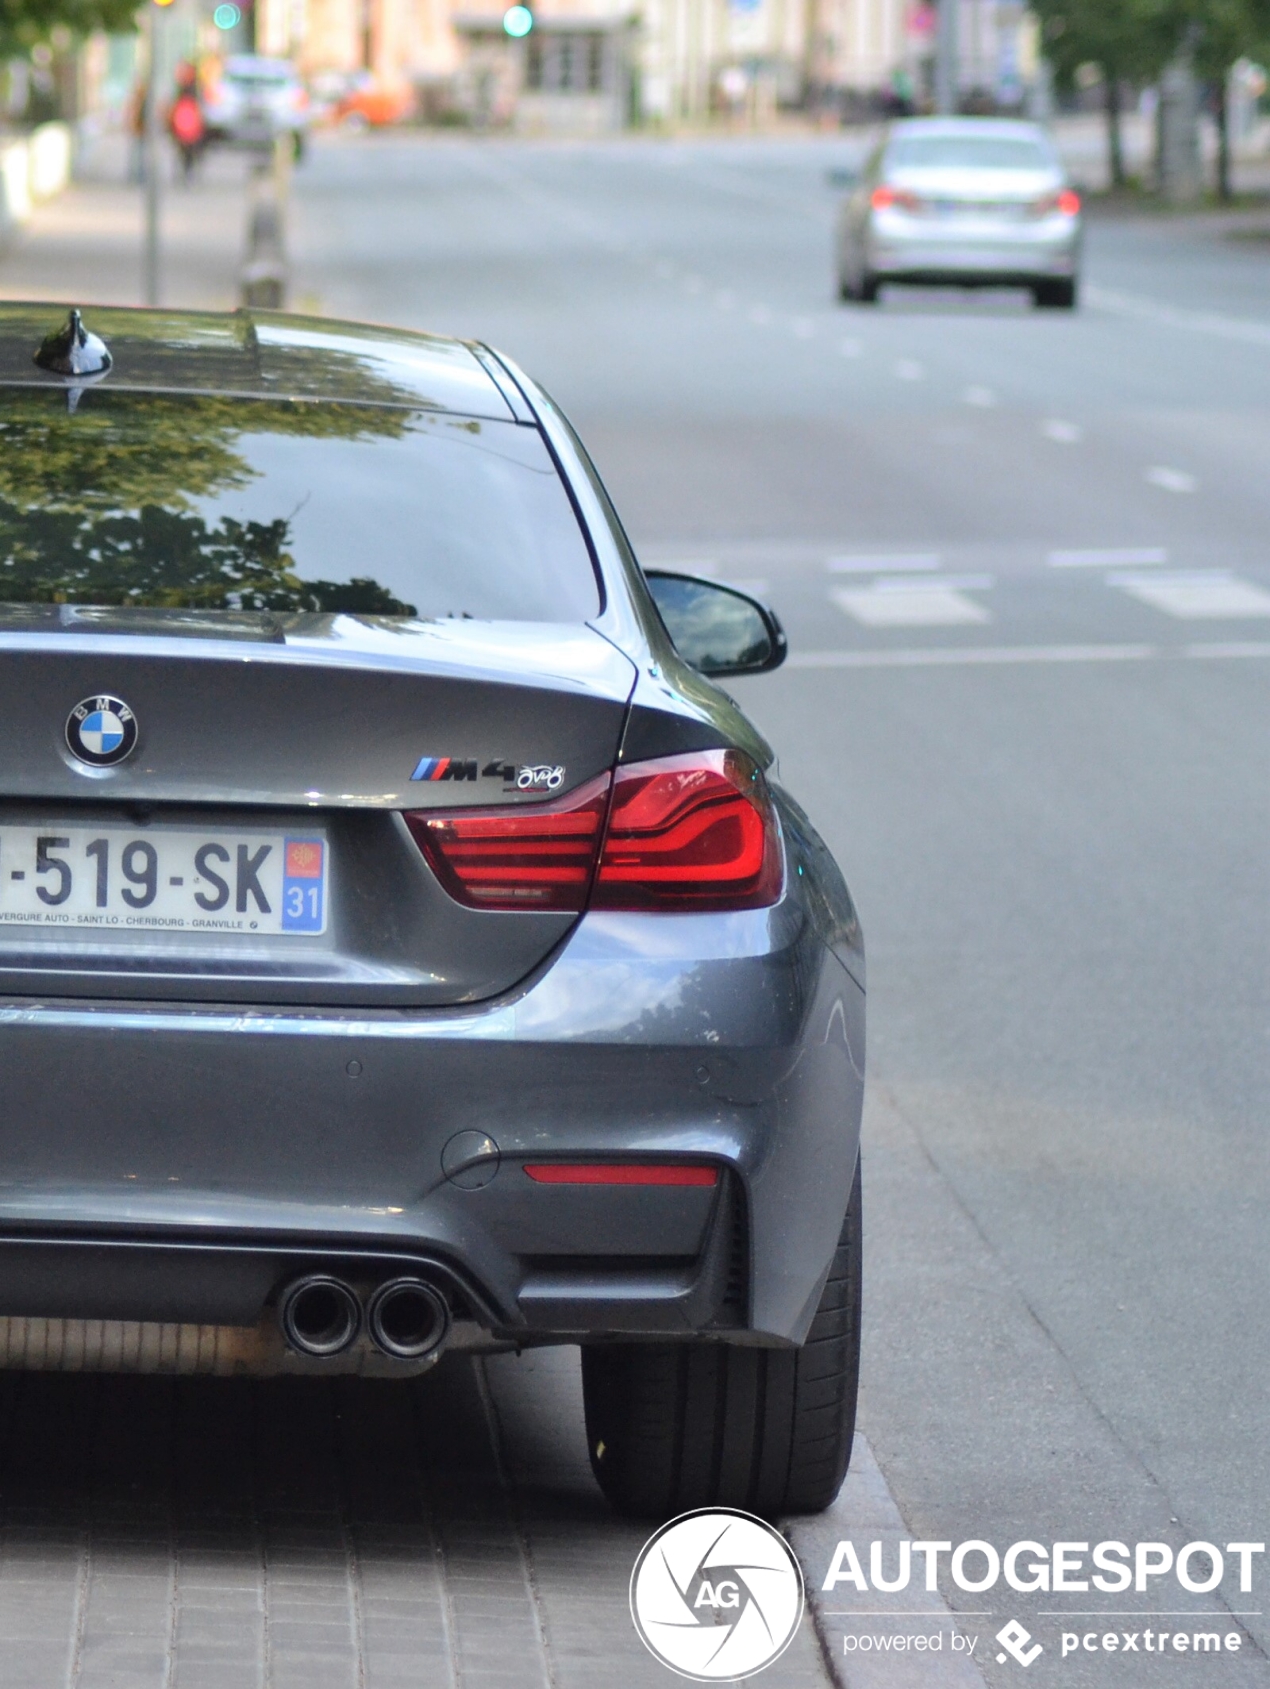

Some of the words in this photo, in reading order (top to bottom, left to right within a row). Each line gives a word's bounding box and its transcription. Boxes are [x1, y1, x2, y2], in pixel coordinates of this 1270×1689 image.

[73, 698, 133, 722] BMW
[442, 757, 516, 782] M4
[286, 886, 319, 920] 31
[44, 912, 70, 923] AUTO
[77, 914, 104, 924] SAINT
[106, 916, 119, 925] LO
[126, 917, 185, 927] CHERBOURG
[192, 918, 243, 929] GRANVILLE
